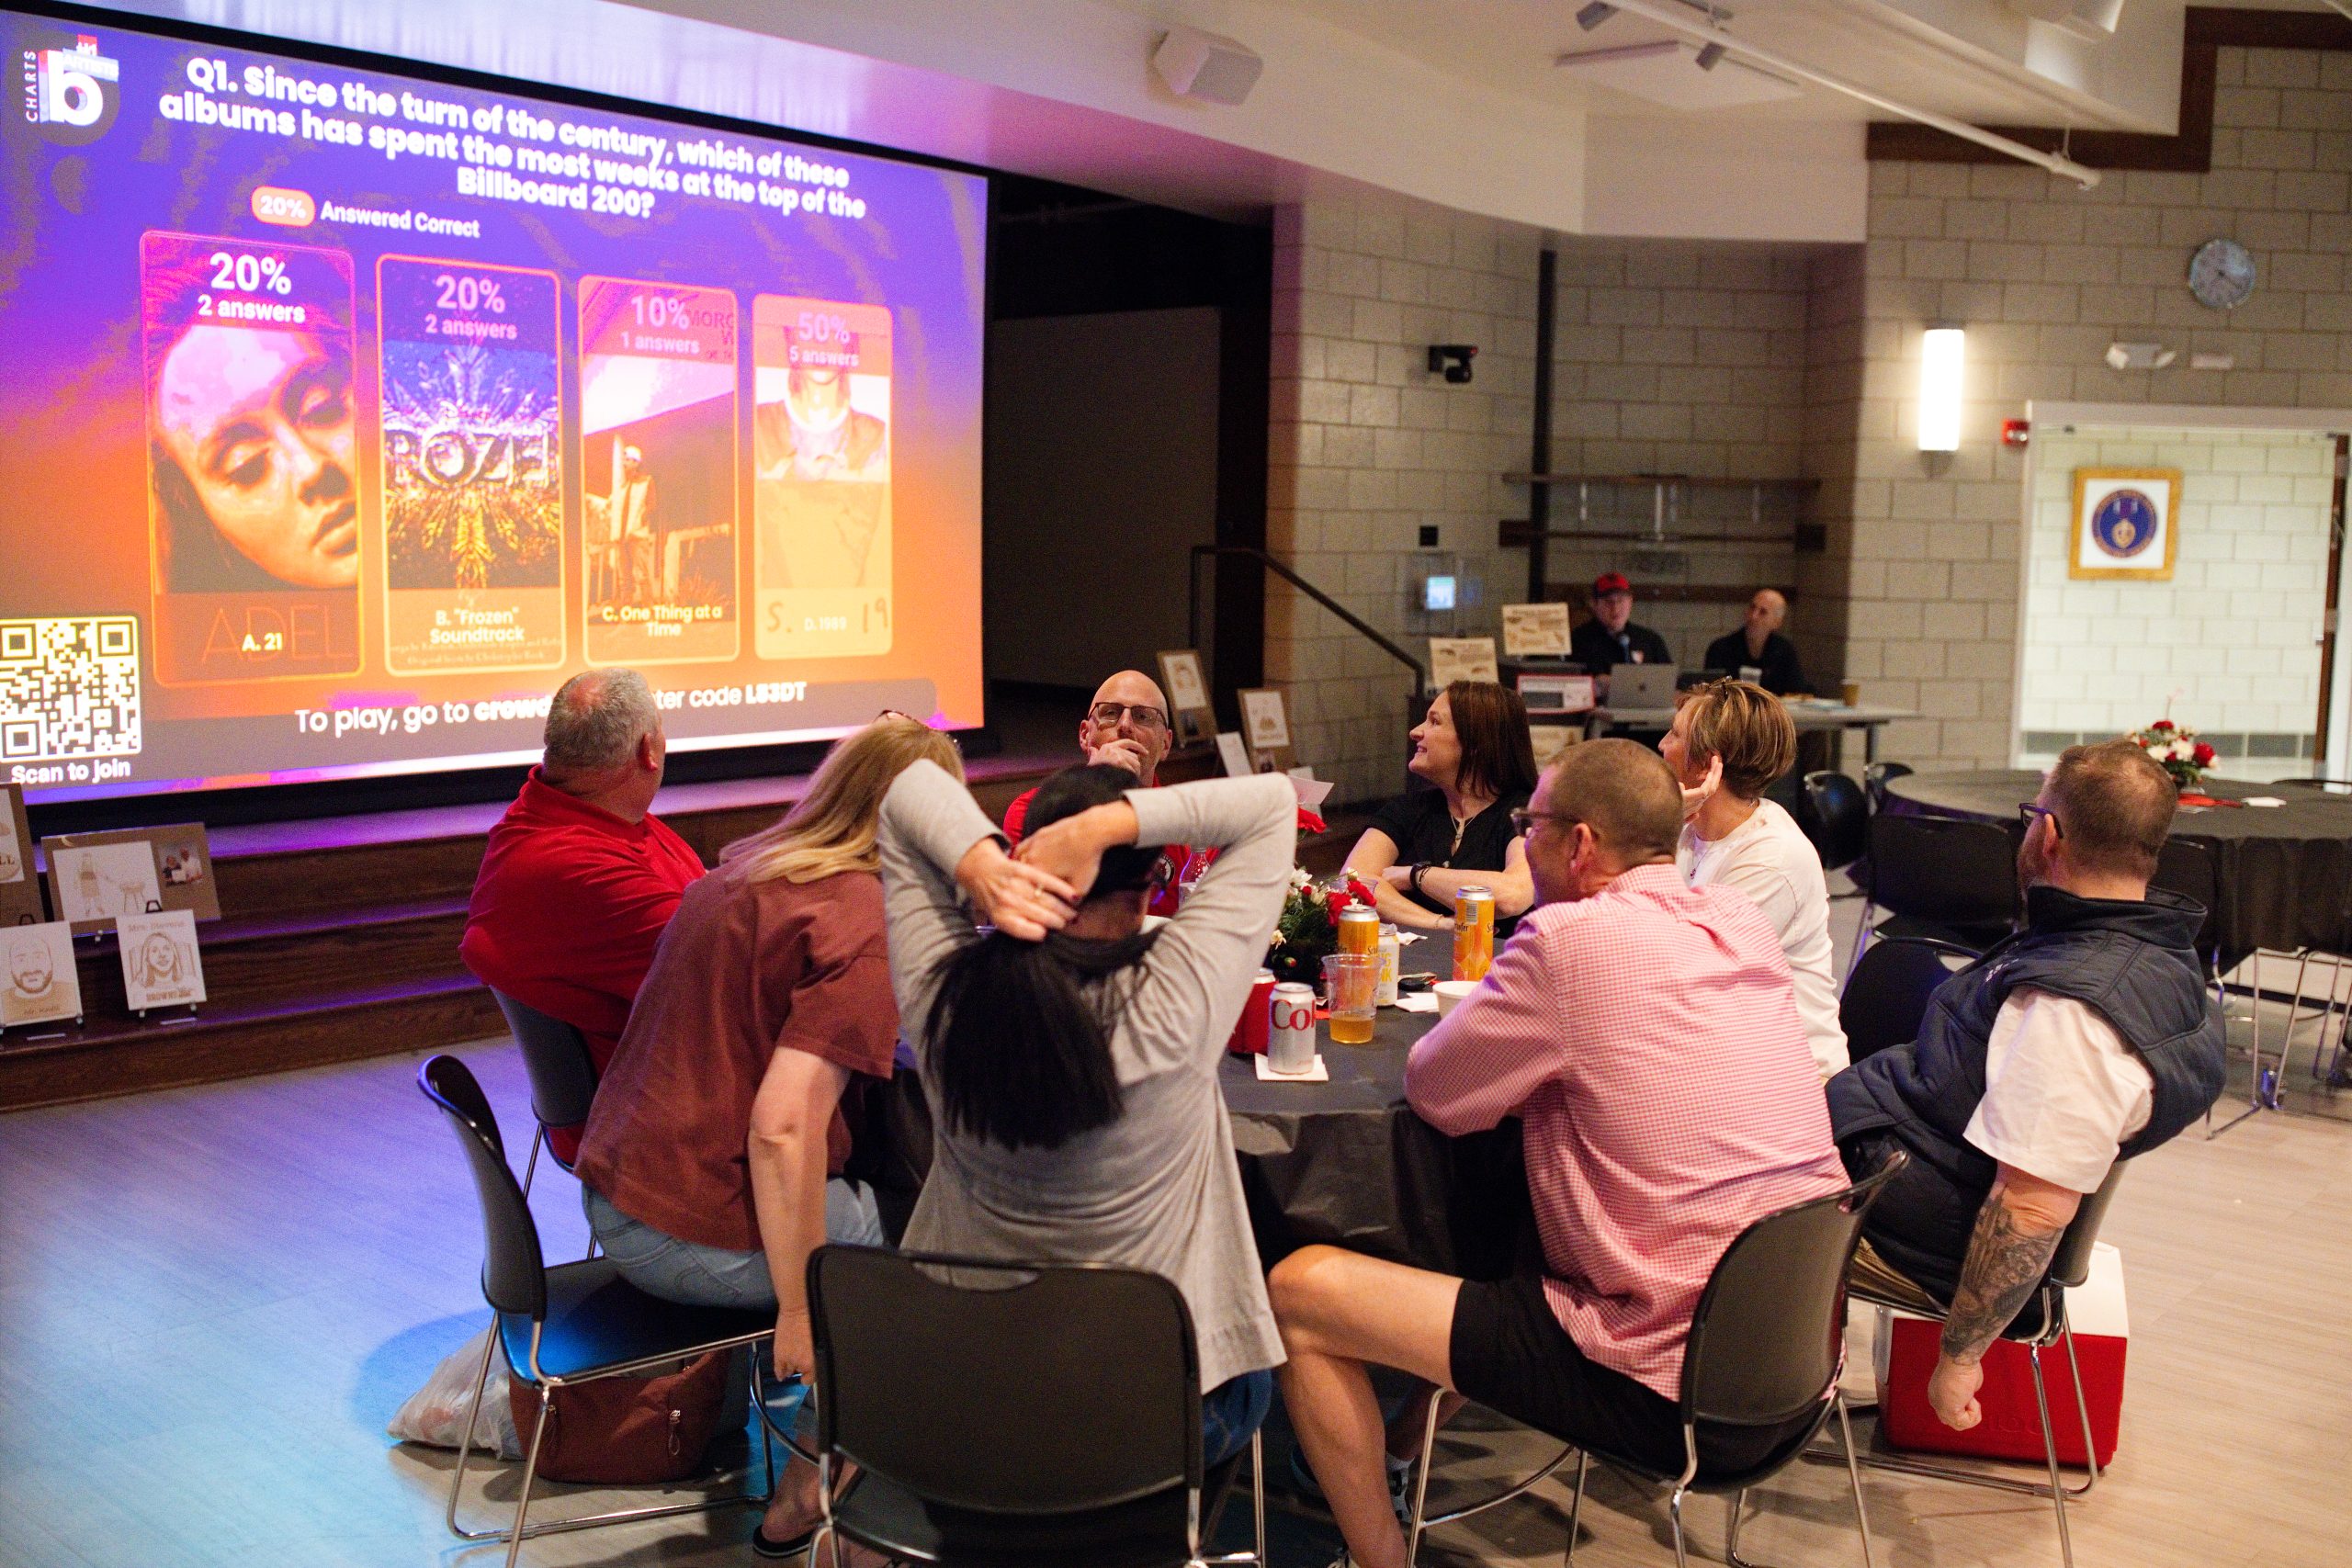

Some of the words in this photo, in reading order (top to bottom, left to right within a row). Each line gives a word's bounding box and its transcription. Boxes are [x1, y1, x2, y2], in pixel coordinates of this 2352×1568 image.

[23, 50, 39, 122] CHARTS
[187, 57, 238, 93] Q1.
[243, 65, 337, 107] Since
[342, 82, 397, 117] the
[401, 92, 469, 129] turn
[472, 104, 503, 133] of
[506, 108, 556, 141] the
[559, 122, 673, 167] century,
[677, 139, 753, 174] which
[756, 151, 782, 178] of
[784, 155, 850, 188] these
[159, 90, 296, 136] albums
[301, 108, 364, 146] has
[368, 125, 458, 160] spent
[462, 134, 513, 167] the
[516, 147, 591, 179] most
[594, 158, 679, 191] weeks
[683, 171, 711, 197] at
[714, 174, 756, 203] the
[758, 179, 799, 217] top
[801, 186, 826, 213] of
[828, 190, 866, 219] the
[458, 166, 588, 210] Billboard
[591, 185, 656, 219] 200?
[259, 195, 307, 219] 20%
[320, 200, 412, 231] Answered
[415, 212, 481, 238] Correct
[209, 251, 292, 295] 20%
[435, 274, 506, 313] 20%
[198, 294, 213, 316] 2
[217, 300, 306, 323] answers
[631, 294, 690, 330] 10%
[425, 313, 438, 333] 2
[442, 318, 518, 340] answers
[797, 310, 851, 344] 50%
[621, 331, 630, 349] 1
[635, 334, 700, 355] answers
[789, 344, 798, 362] 5
[802, 349, 859, 367] answers
[435, 609, 451, 626] B.
[454, 605, 520, 626] "Frozen"
[602, 606, 618, 621] C.
[620, 605, 650, 621] One
[652, 604, 693, 623] Thing
[695, 604, 710, 619] at
[712, 605, 722, 618] a
[804, 616, 816, 631] D.
[819, 615, 847, 631] 1989
[242, 633, 262, 652] A.
[264, 632, 283, 651] 21
[430, 625, 526, 644] Soundtrack
[646, 621, 683, 637] Time
[295, 709, 328, 733] To
[334, 706, 398, 738] play,
[403, 705, 438, 733] go
[443, 701, 469, 723] to
[655, 689, 684, 710] ter
[689, 685, 742, 708] code
[11, 765, 63, 784] Scan
[67, 762, 89, 781] to
[92, 758, 130, 784] join
